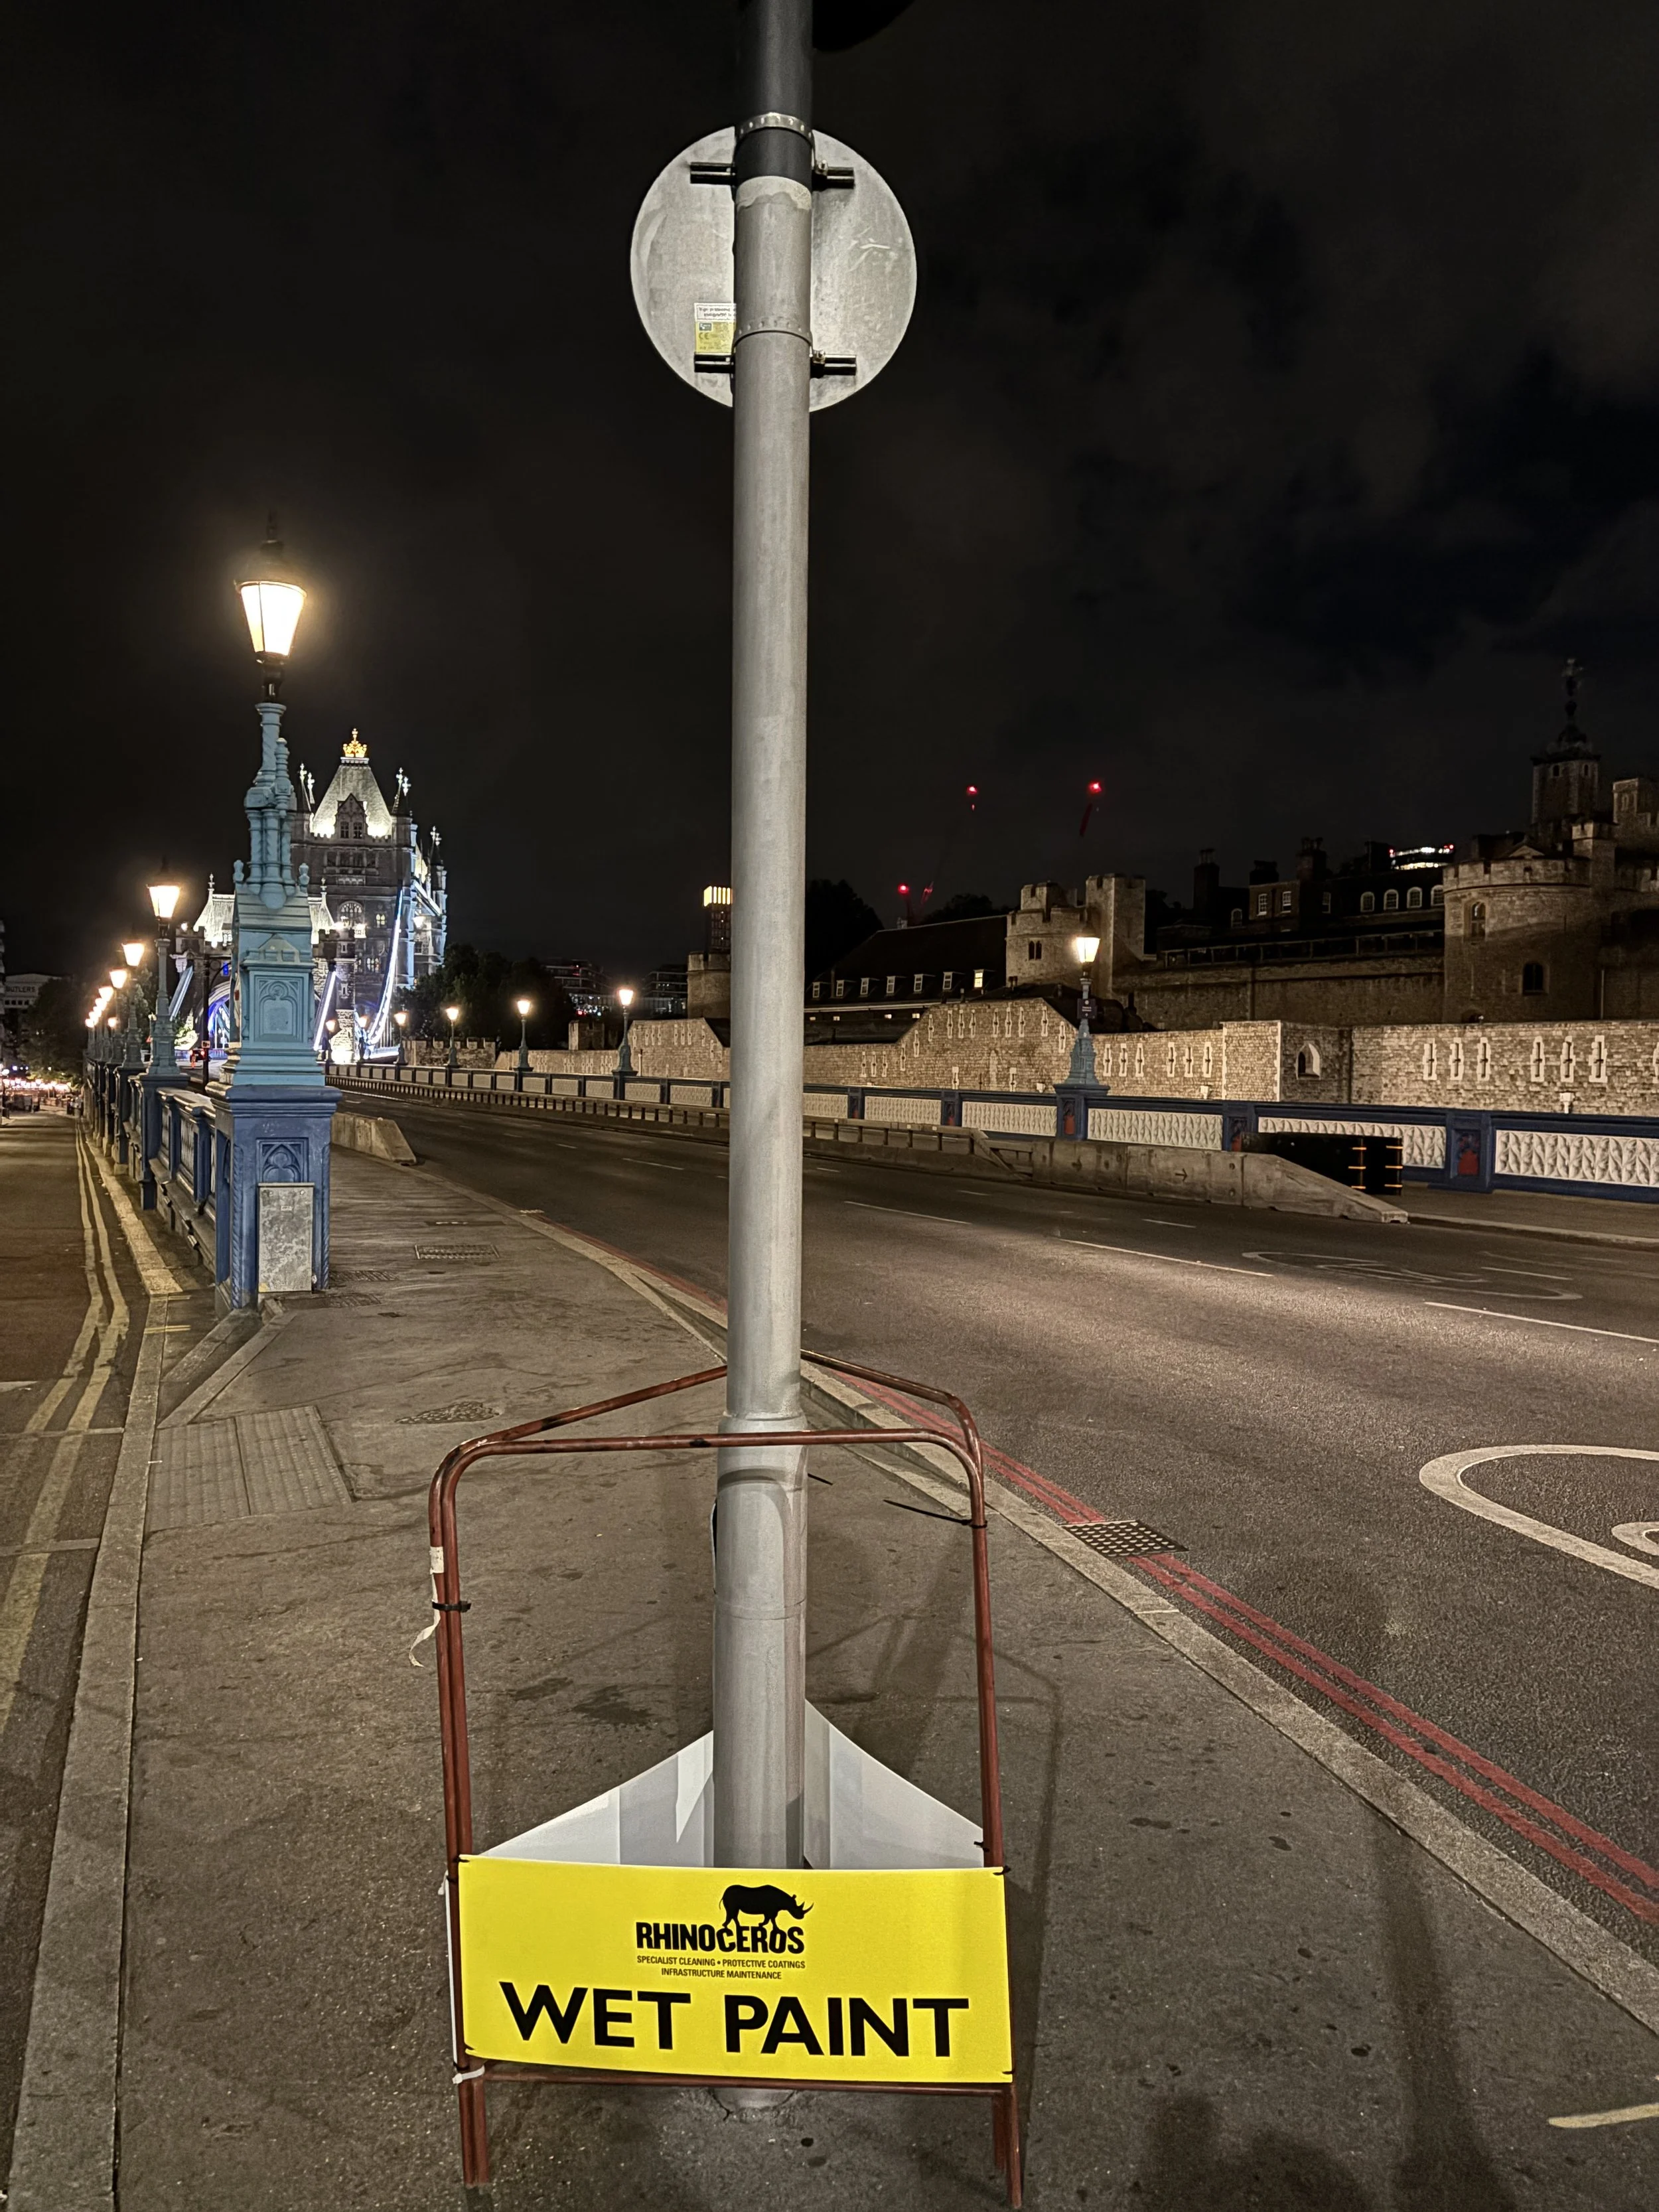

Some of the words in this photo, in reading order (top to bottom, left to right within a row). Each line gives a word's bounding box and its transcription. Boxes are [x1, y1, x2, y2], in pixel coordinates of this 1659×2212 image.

[636, 1922, 804, 1954] RHINOCEROS
[637, 1956, 677, 1964] SPECIALIST
[679, 1957, 715, 1966] CLEANING
[723, 1959, 766, 1968] PROTECTIVE
[662, 1968, 724, 1977] INFRASTRUCTURE
[727, 1970, 781, 1979] MAINTENANCE
[499, 1981, 691, 2049] WET
[725, 1995, 969, 2057] PAINT
